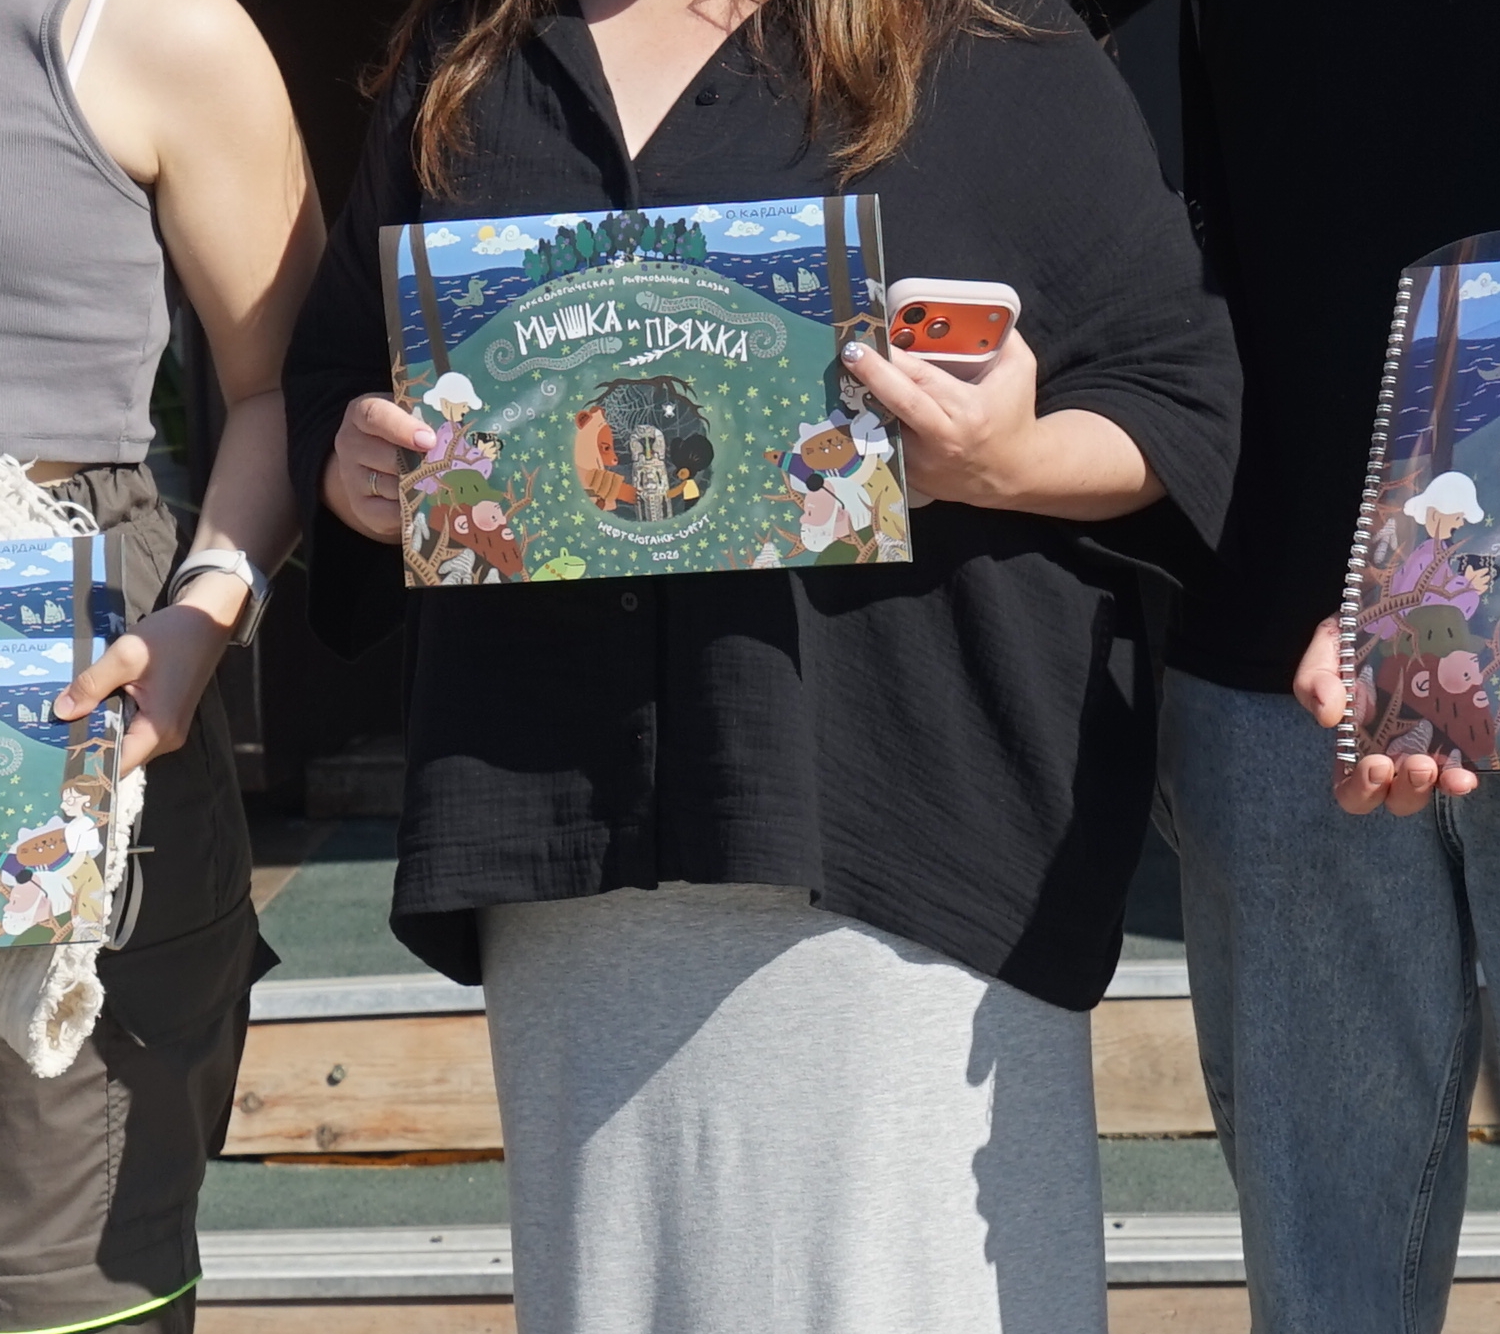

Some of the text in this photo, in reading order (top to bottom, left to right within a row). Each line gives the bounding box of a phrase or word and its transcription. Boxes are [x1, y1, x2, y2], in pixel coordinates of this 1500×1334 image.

[514, 300, 622, 355] МЫШКА
[645, 316, 748, 362] ПРЯЖКА
[651, 550, 679, 561] 2026
